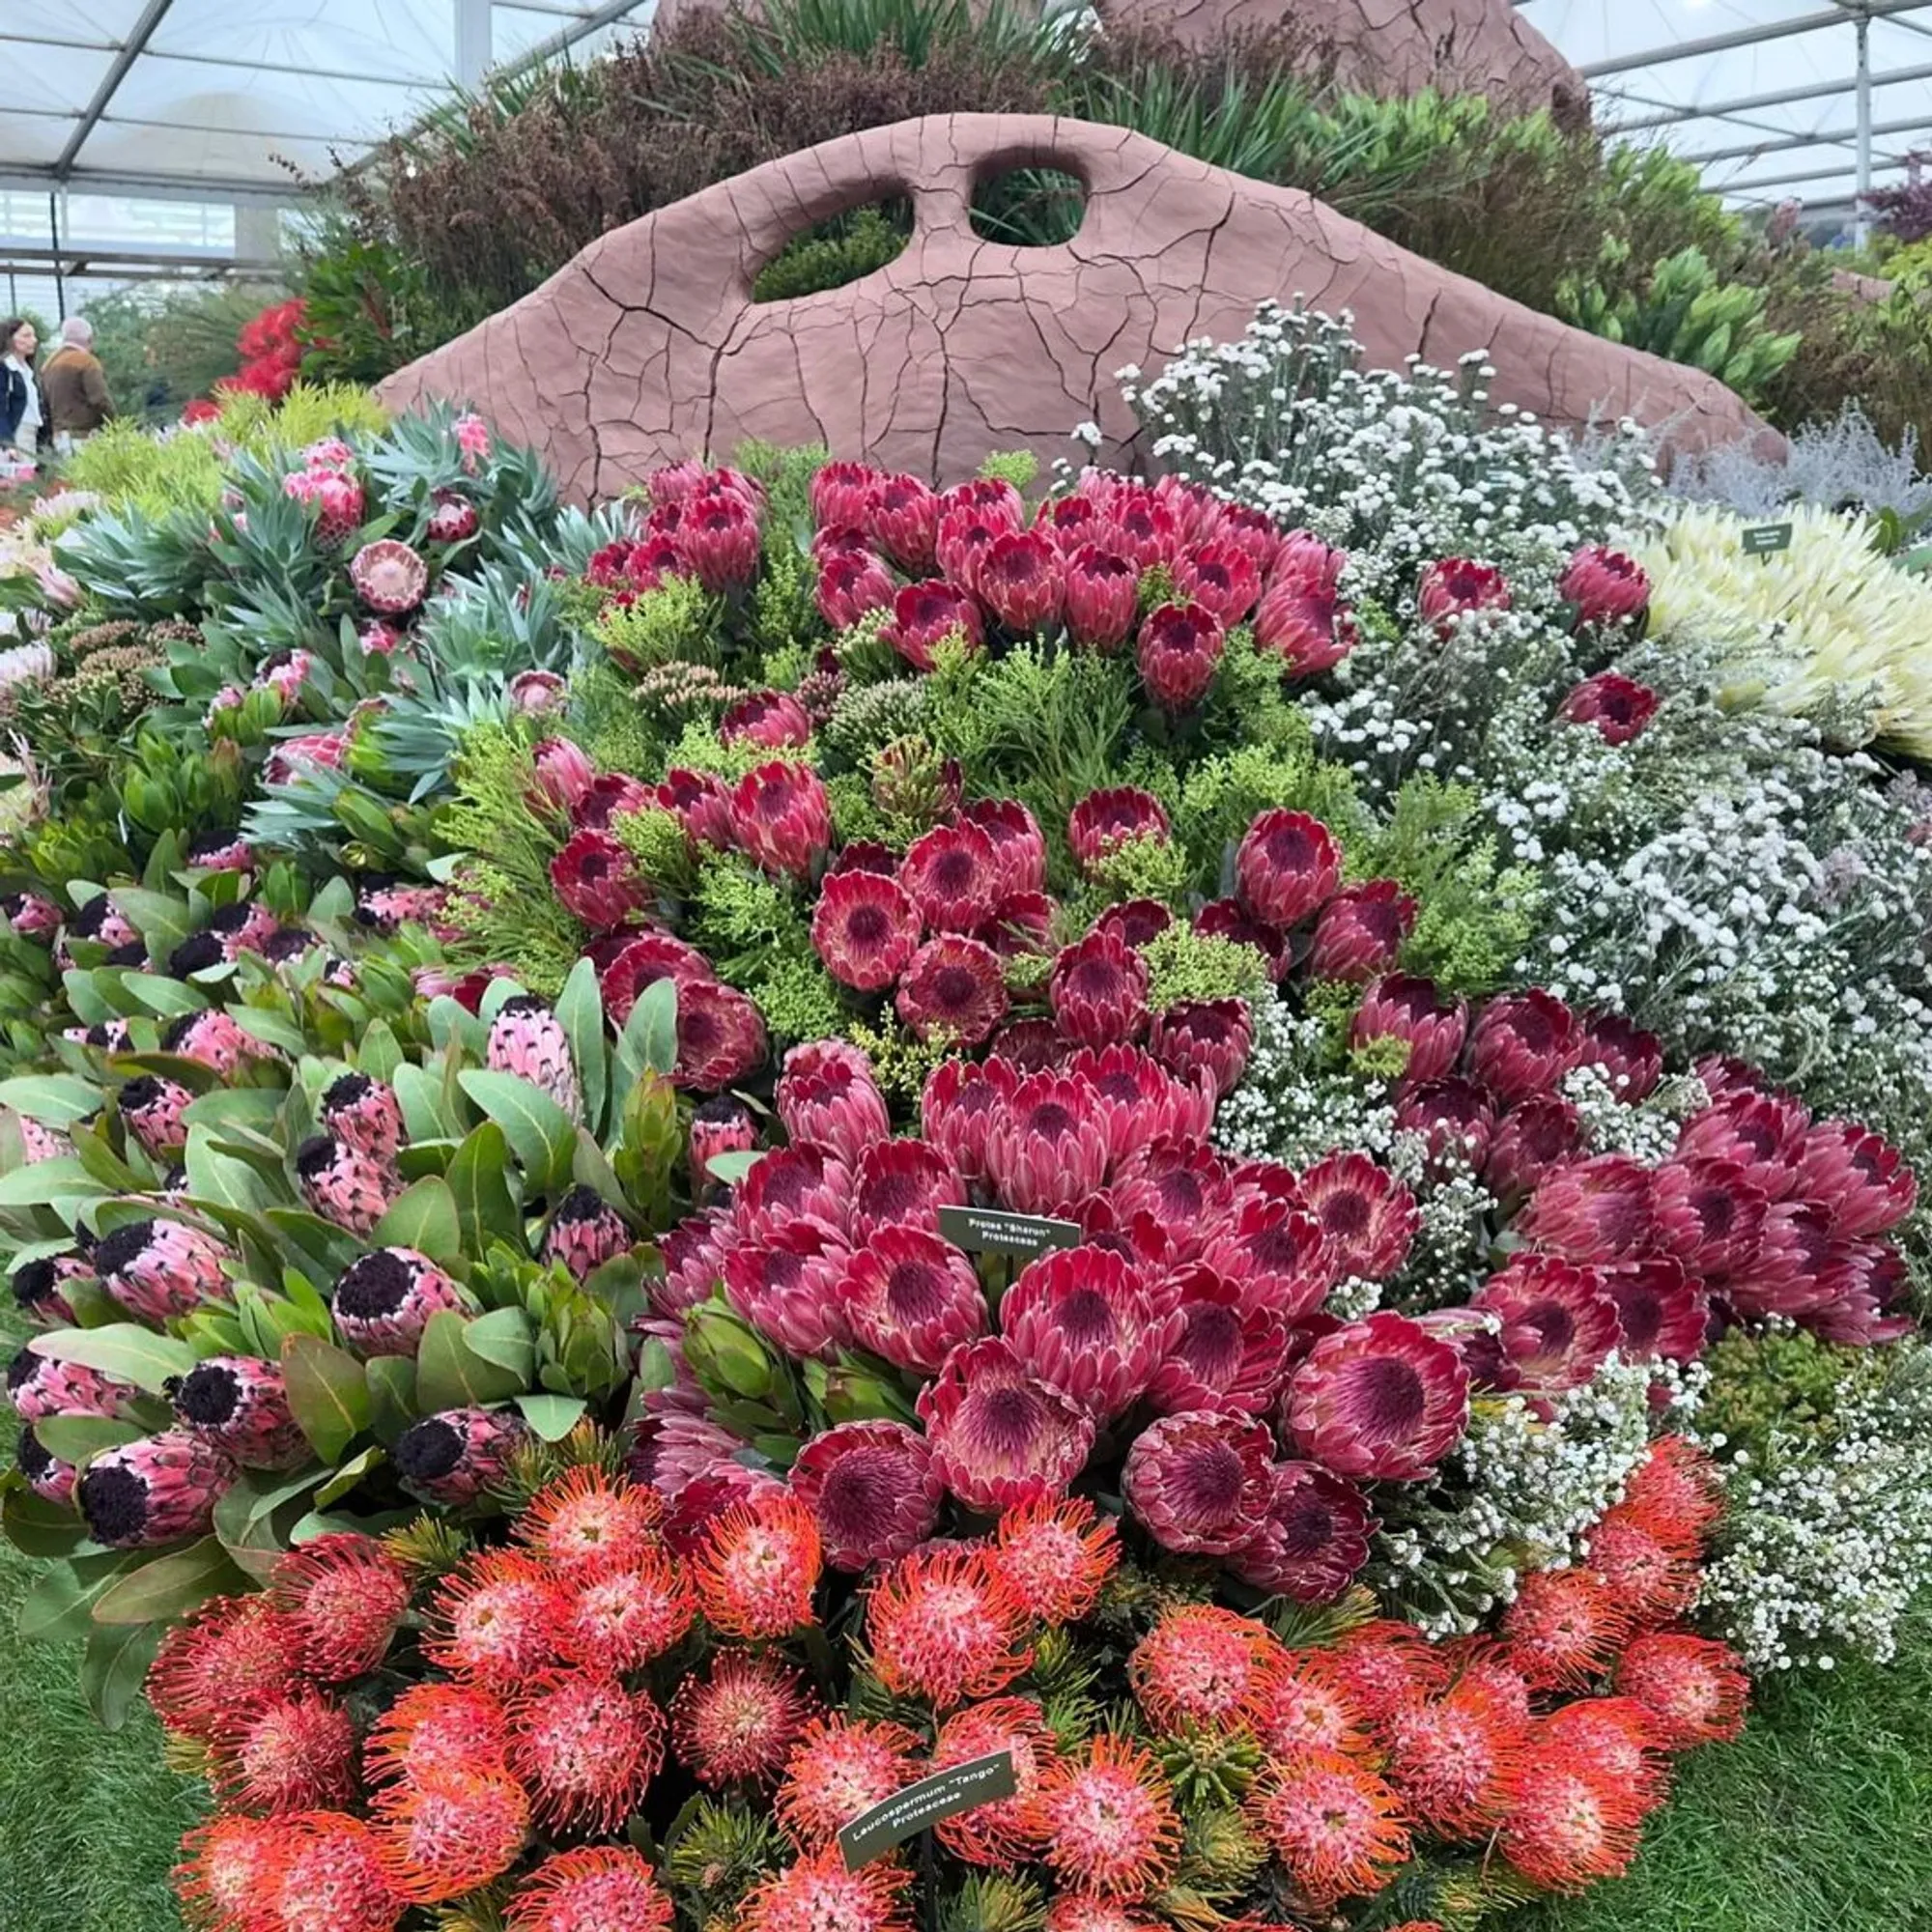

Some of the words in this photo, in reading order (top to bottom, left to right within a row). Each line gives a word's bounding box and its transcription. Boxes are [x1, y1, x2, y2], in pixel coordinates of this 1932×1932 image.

[852, 1785, 946, 1841] Leucospermum
[949, 1763, 1000, 1785] "Tango"
[892, 1791, 962, 1829] Proteaceae
